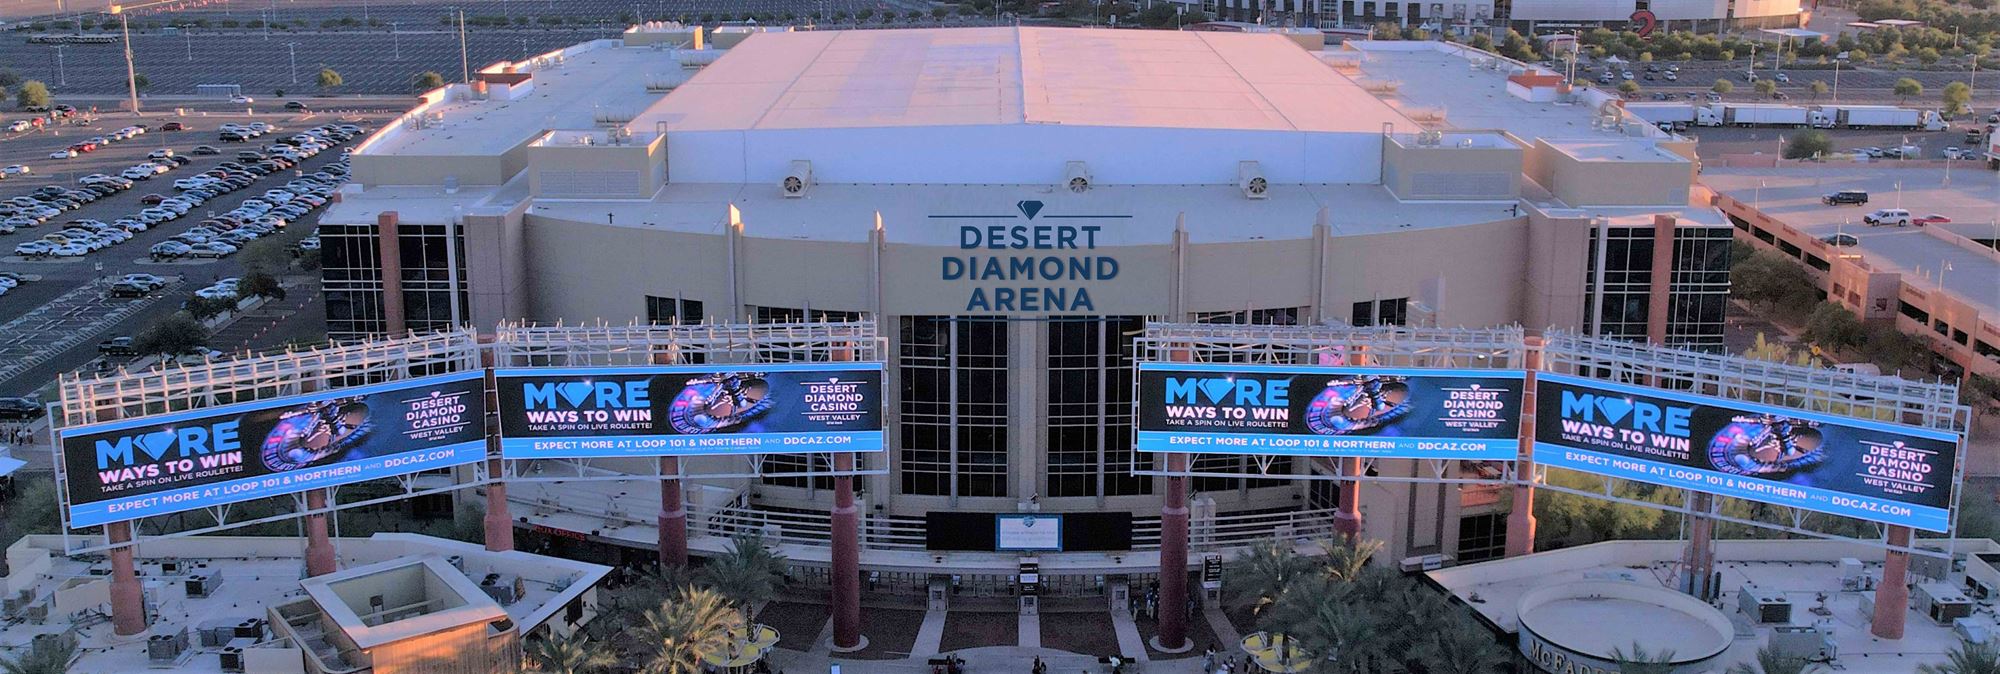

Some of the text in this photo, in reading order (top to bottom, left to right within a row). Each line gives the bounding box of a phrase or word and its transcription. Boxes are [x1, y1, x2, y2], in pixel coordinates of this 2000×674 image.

[810, 384, 858, 394] DESERT
[1450, 391, 1499, 401] DESERT
[412, 395, 461, 411] DESERT
[804, 393, 864, 403] DIAMOND
[1443, 400, 1504, 410] DIAMOND
[406, 404, 467, 421] DIAMOND
[811, 402, 858, 412] CASINO
[1165, 406, 1289, 420] WAYS TO WIN
[1448, 409, 1497, 418] CASINO
[412, 414, 461, 429] CASINO
[526, 409, 652, 423] WAYS TO WIN
[410, 429, 433, 440] WEST
[434, 425, 464, 437] VALLEY
[1561, 419, 1690, 452] WAYS TO WIN
[534, 441, 577, 450] EXPECT
[581, 441, 612, 449] MORE
[617, 440, 632, 448] AT
[635, 440, 666, 448] LOOP
[670, 439, 686, 447] 101
[689, 439, 696, 447] &
[699, 437, 761, 447] NORTHERN
[783, 435, 851, 445] DDCAZ.COM
[1169, 436, 1212, 445] EXPECT
[1215, 437, 1248, 446] MORE
[1251, 438, 1266, 446] AT
[1269, 439, 1300, 447] LOOP
[1322, 440, 1330, 448] &
[1333, 440, 1396, 449] NORTHERN
[1417, 442, 1487, 451] DDCAZ.COM
[1561, 433, 1582, 443] TAKE
[1591, 436, 1610, 447] SPIN
[1611, 440, 1623, 449] ON
[1625, 442, 1643, 453] LIVE
[1644, 446, 1690, 460] ROULETTE!
[1869, 445, 1926, 462] DESERT
[98, 451, 243, 484] WAYS TO WIN
[1862, 454, 1932, 474] DIAMOND
[101, 483, 124, 493] TAKE
[135, 478, 156, 488] SPIN
[158, 476, 172, 485] ON
[174, 473, 194, 482] LIVE
[196, 466, 243, 479] ROULETTE!
[108, 497, 159, 513] EXPECT
[162, 492, 200, 506] MORE
[203, 487, 220, 498] AT
[223, 481, 259, 495] LOOP
[262, 475, 279, 488] 101
[283, 476, 291, 485] &
[294, 464, 361, 483] NORTHERN
[364, 462, 382, 470] AND
[384, 449, 455, 468] DDCAZ.COM
[1868, 466, 1923, 482] CASINO
[1565, 451, 1610, 466] EXPECT
[1612, 459, 1647, 473] MORE
[1649, 465, 1666, 476] AT
[1669, 469, 1703, 482] LOOP
[1706, 475, 1723, 485] 101
[1726, 478, 1734, 487] &
[1737, 480, 1807, 500] NORTHERN
[1810, 494, 1829, 502] AND
[1831, 496, 1911, 517] DDCAZ.COM
[1863, 477, 1889, 488] WEST
[1890, 482, 1925, 494] VALLEY
